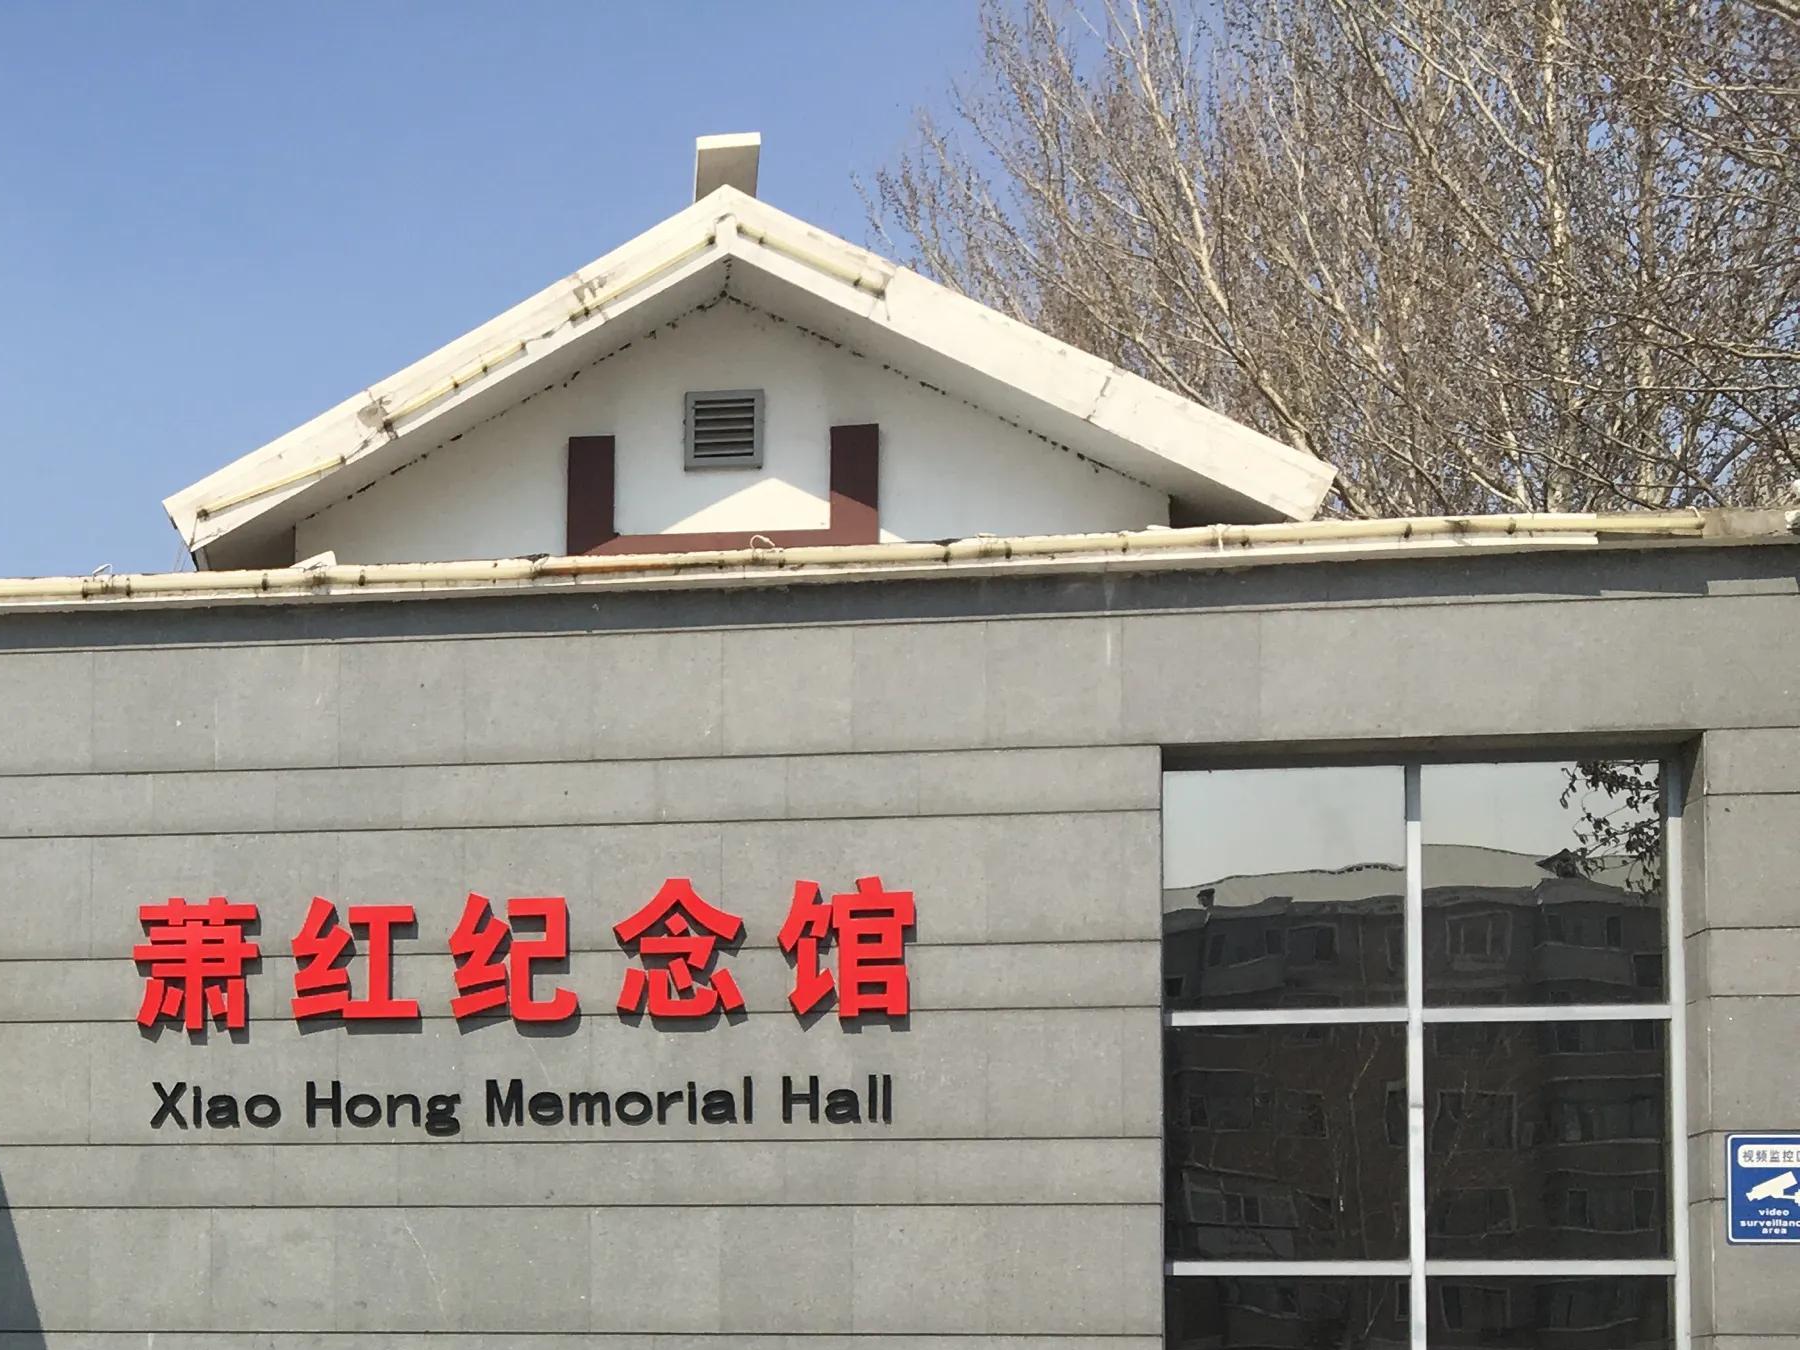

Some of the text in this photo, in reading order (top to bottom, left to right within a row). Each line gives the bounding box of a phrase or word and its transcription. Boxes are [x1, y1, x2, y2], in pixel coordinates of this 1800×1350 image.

[133, 875, 915, 1030] 萧红纪念馆
[151, 1075, 892, 1136] Xiao Hong Memorial Hall
[1758, 1208, 1790, 1216] video
[1761, 1227, 1788, 1235] area
